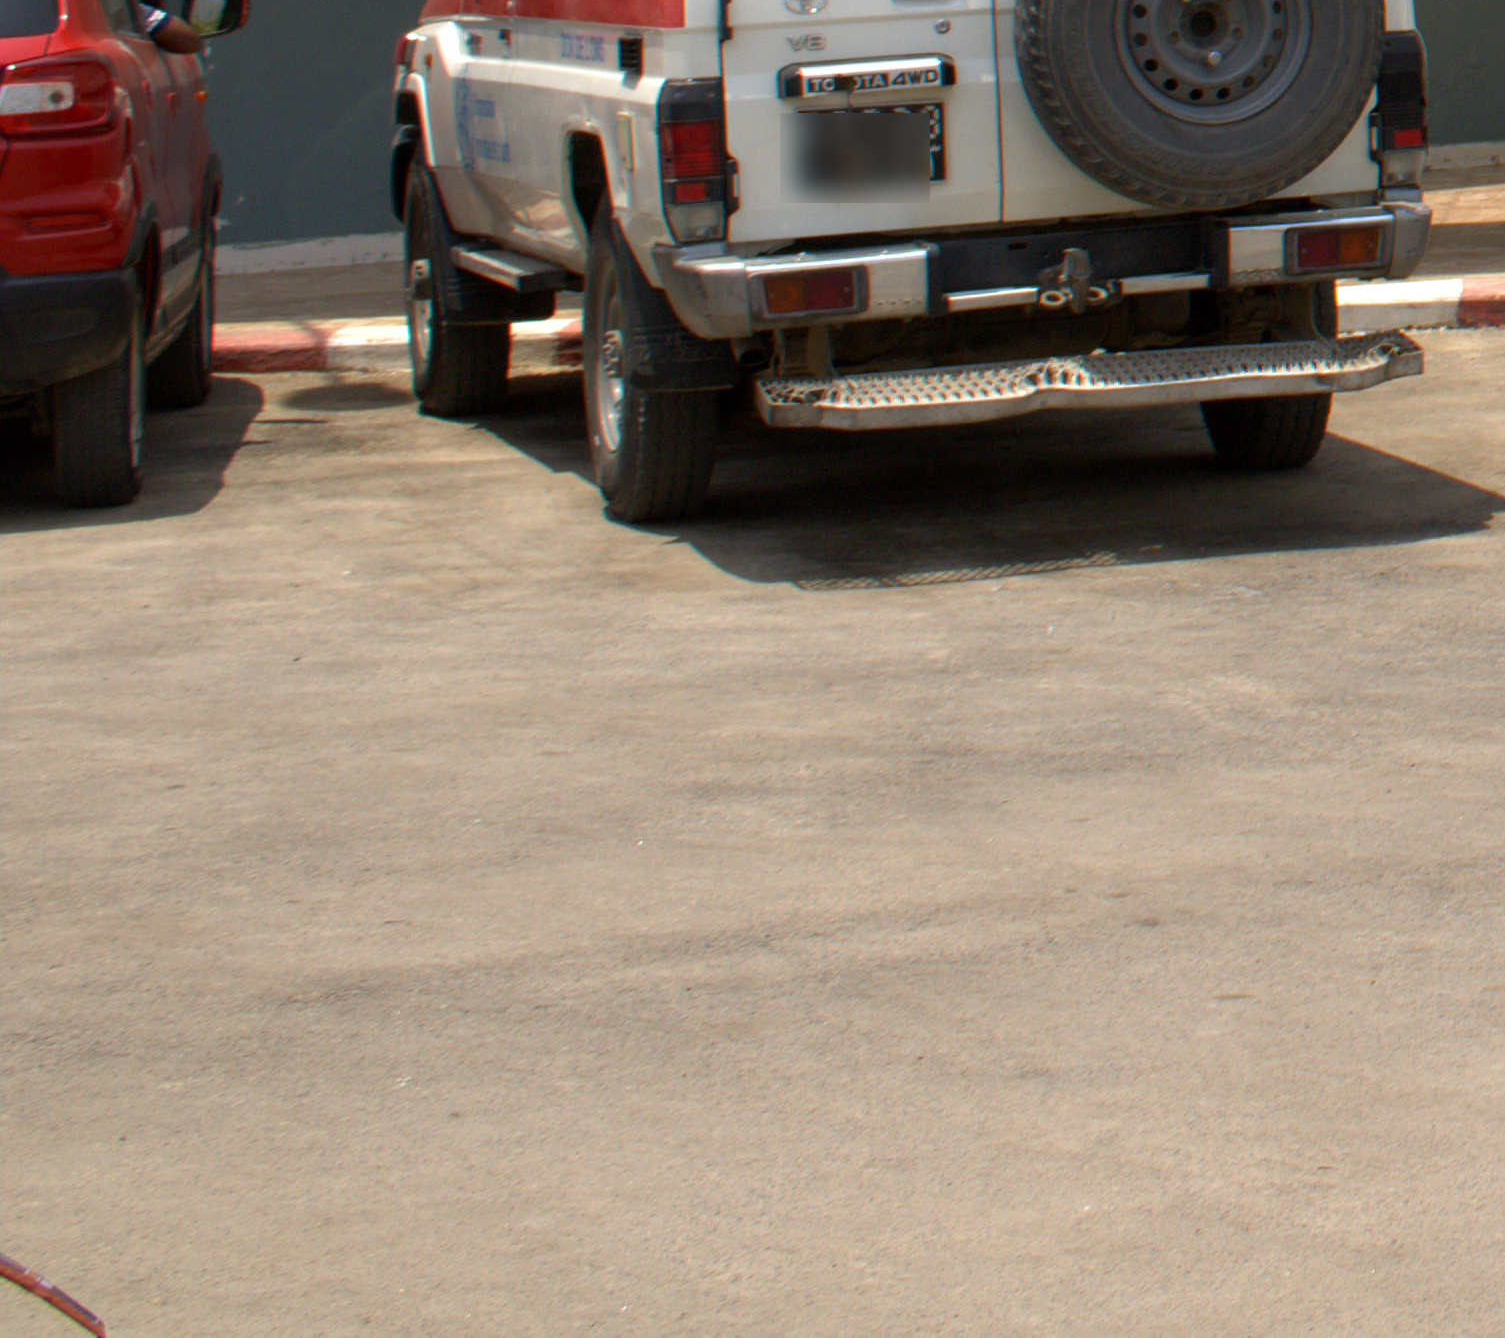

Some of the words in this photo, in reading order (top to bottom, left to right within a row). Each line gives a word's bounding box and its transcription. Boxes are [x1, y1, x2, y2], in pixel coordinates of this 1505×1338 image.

[786, 34, 828, 51] V8
[810, 73, 888, 92] TOOTA
[892, 69, 940, 86] 4WD
